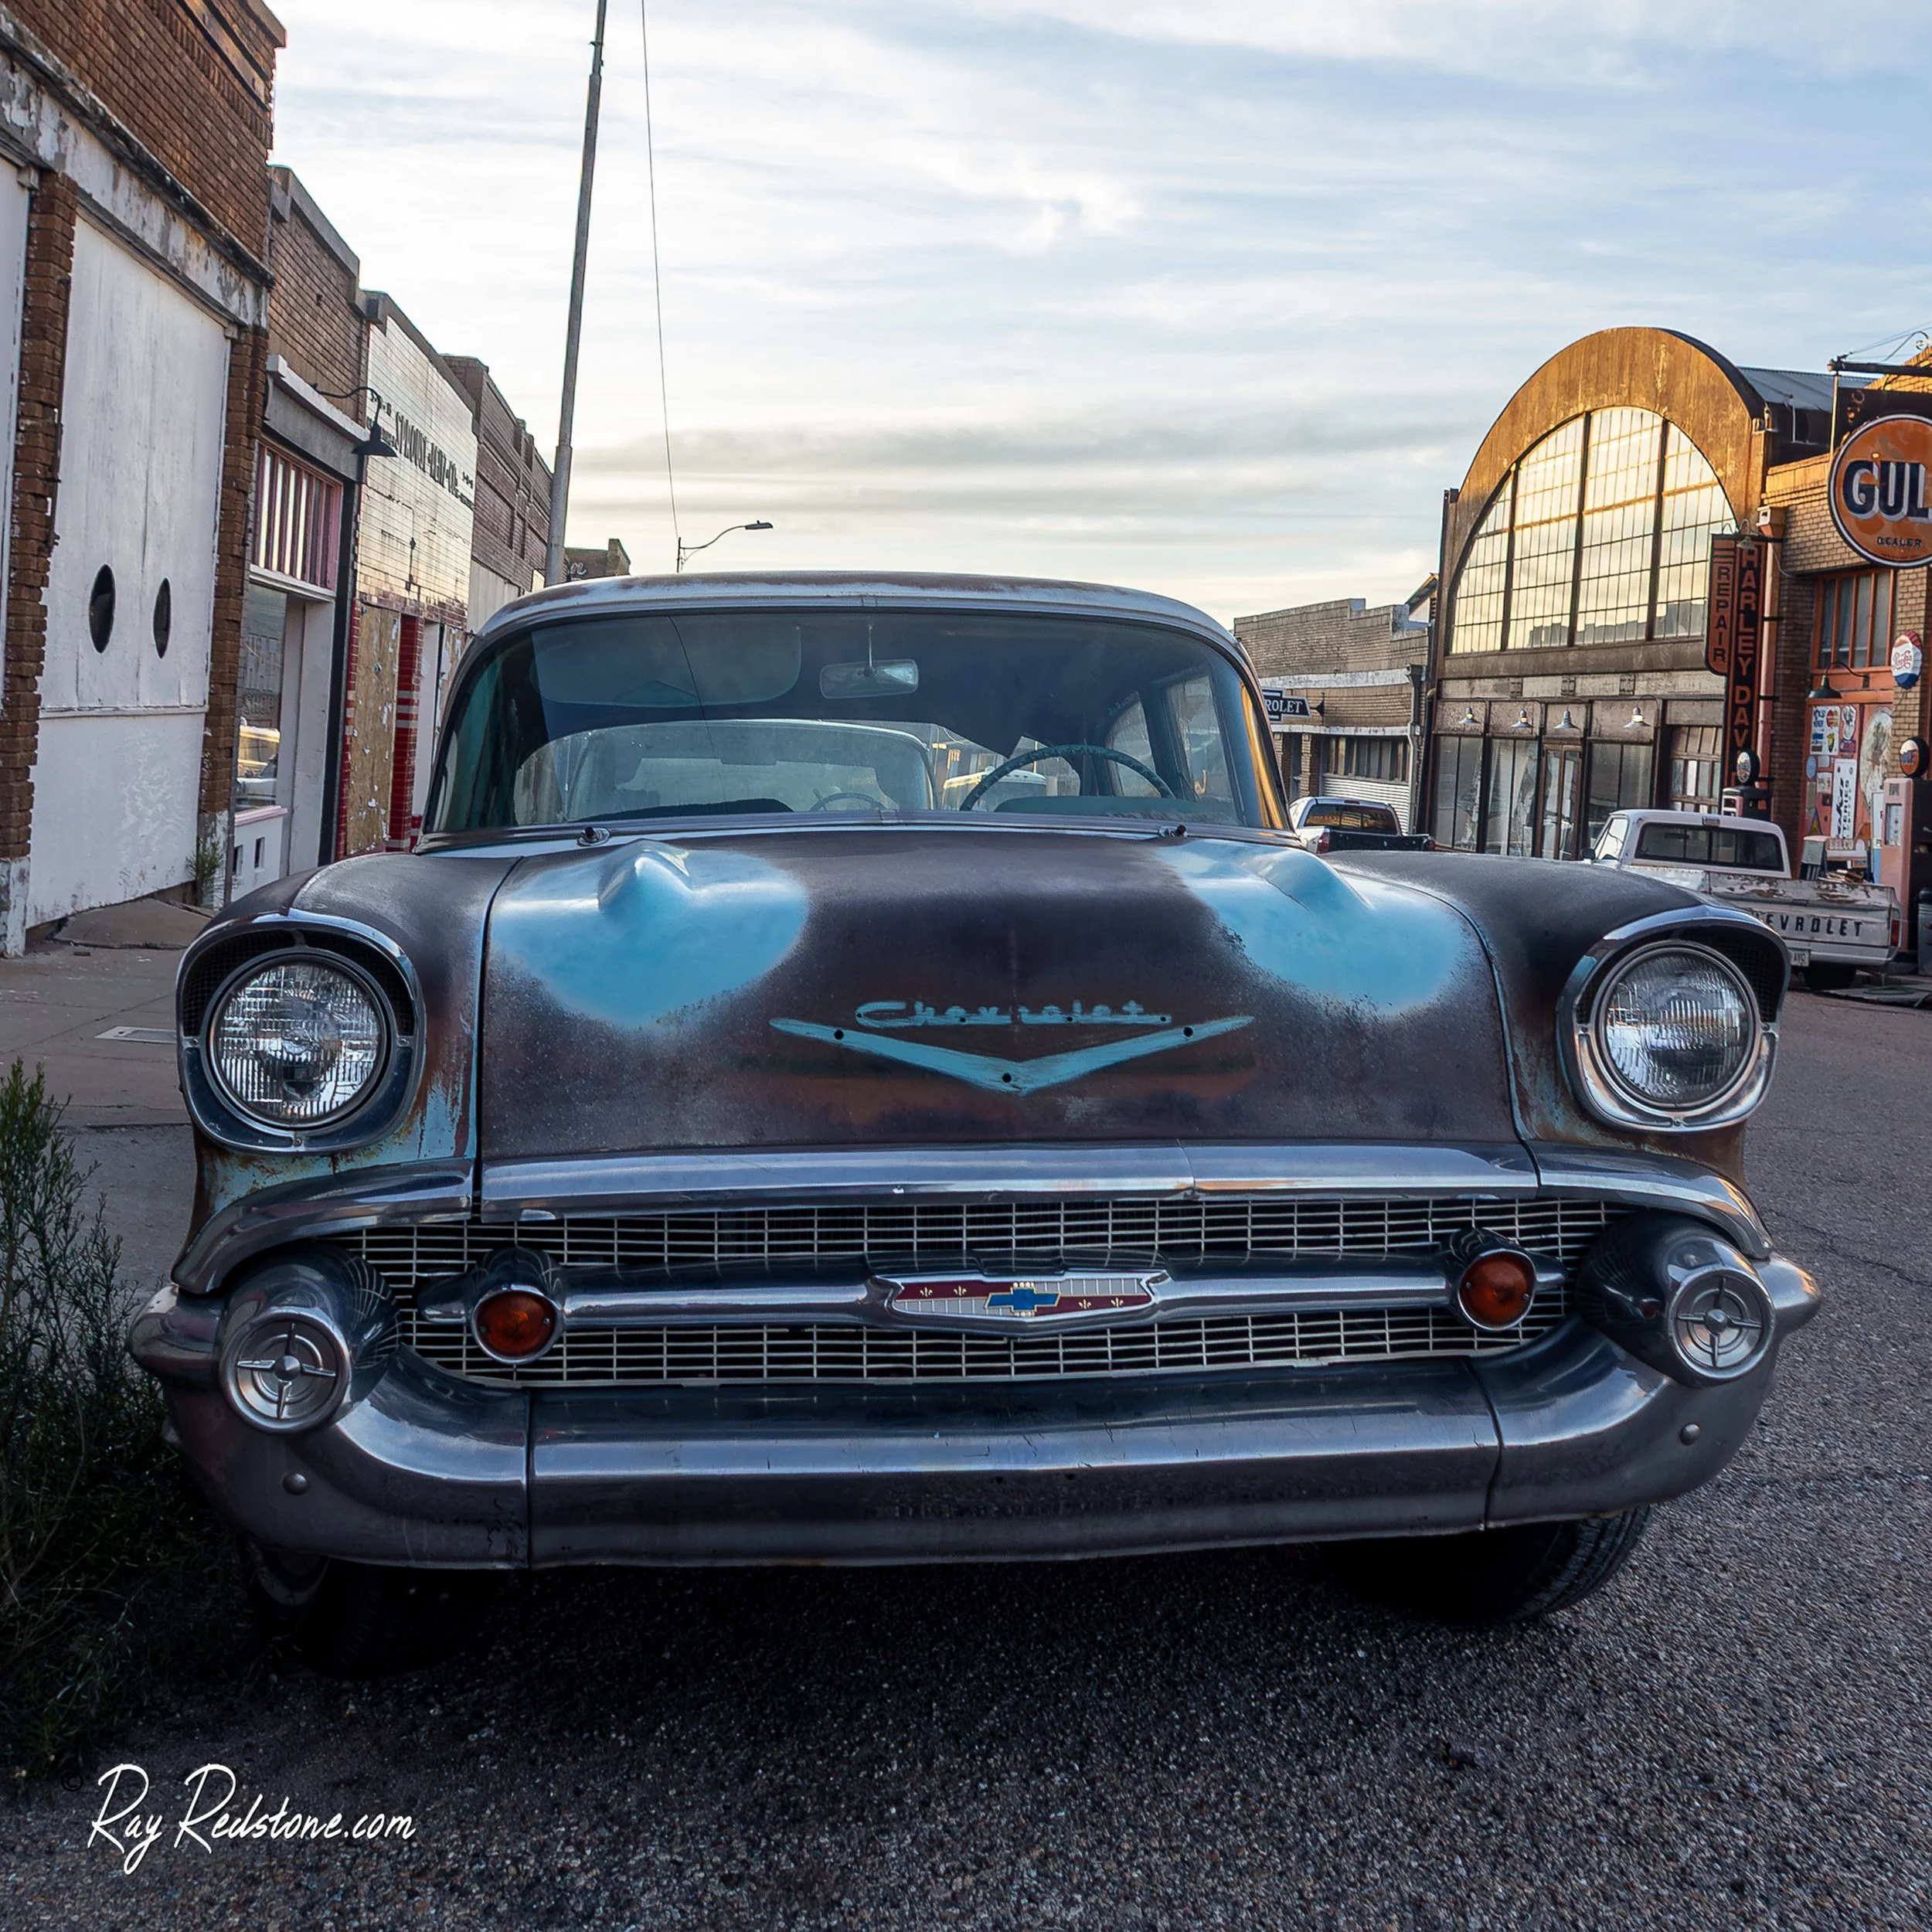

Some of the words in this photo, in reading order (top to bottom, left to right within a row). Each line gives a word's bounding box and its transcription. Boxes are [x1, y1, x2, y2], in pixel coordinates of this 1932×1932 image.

[1877, 536, 1923, 547] DEALER
[1713, 566, 1730, 662] REPAIR
[1738, 546, 1758, 676] HARLEY
[1733, 685, 1752, 754] DAV
[1753, 913, 1862, 937] EVROLET
[855, 998, 1172, 1028] Chevrolet
